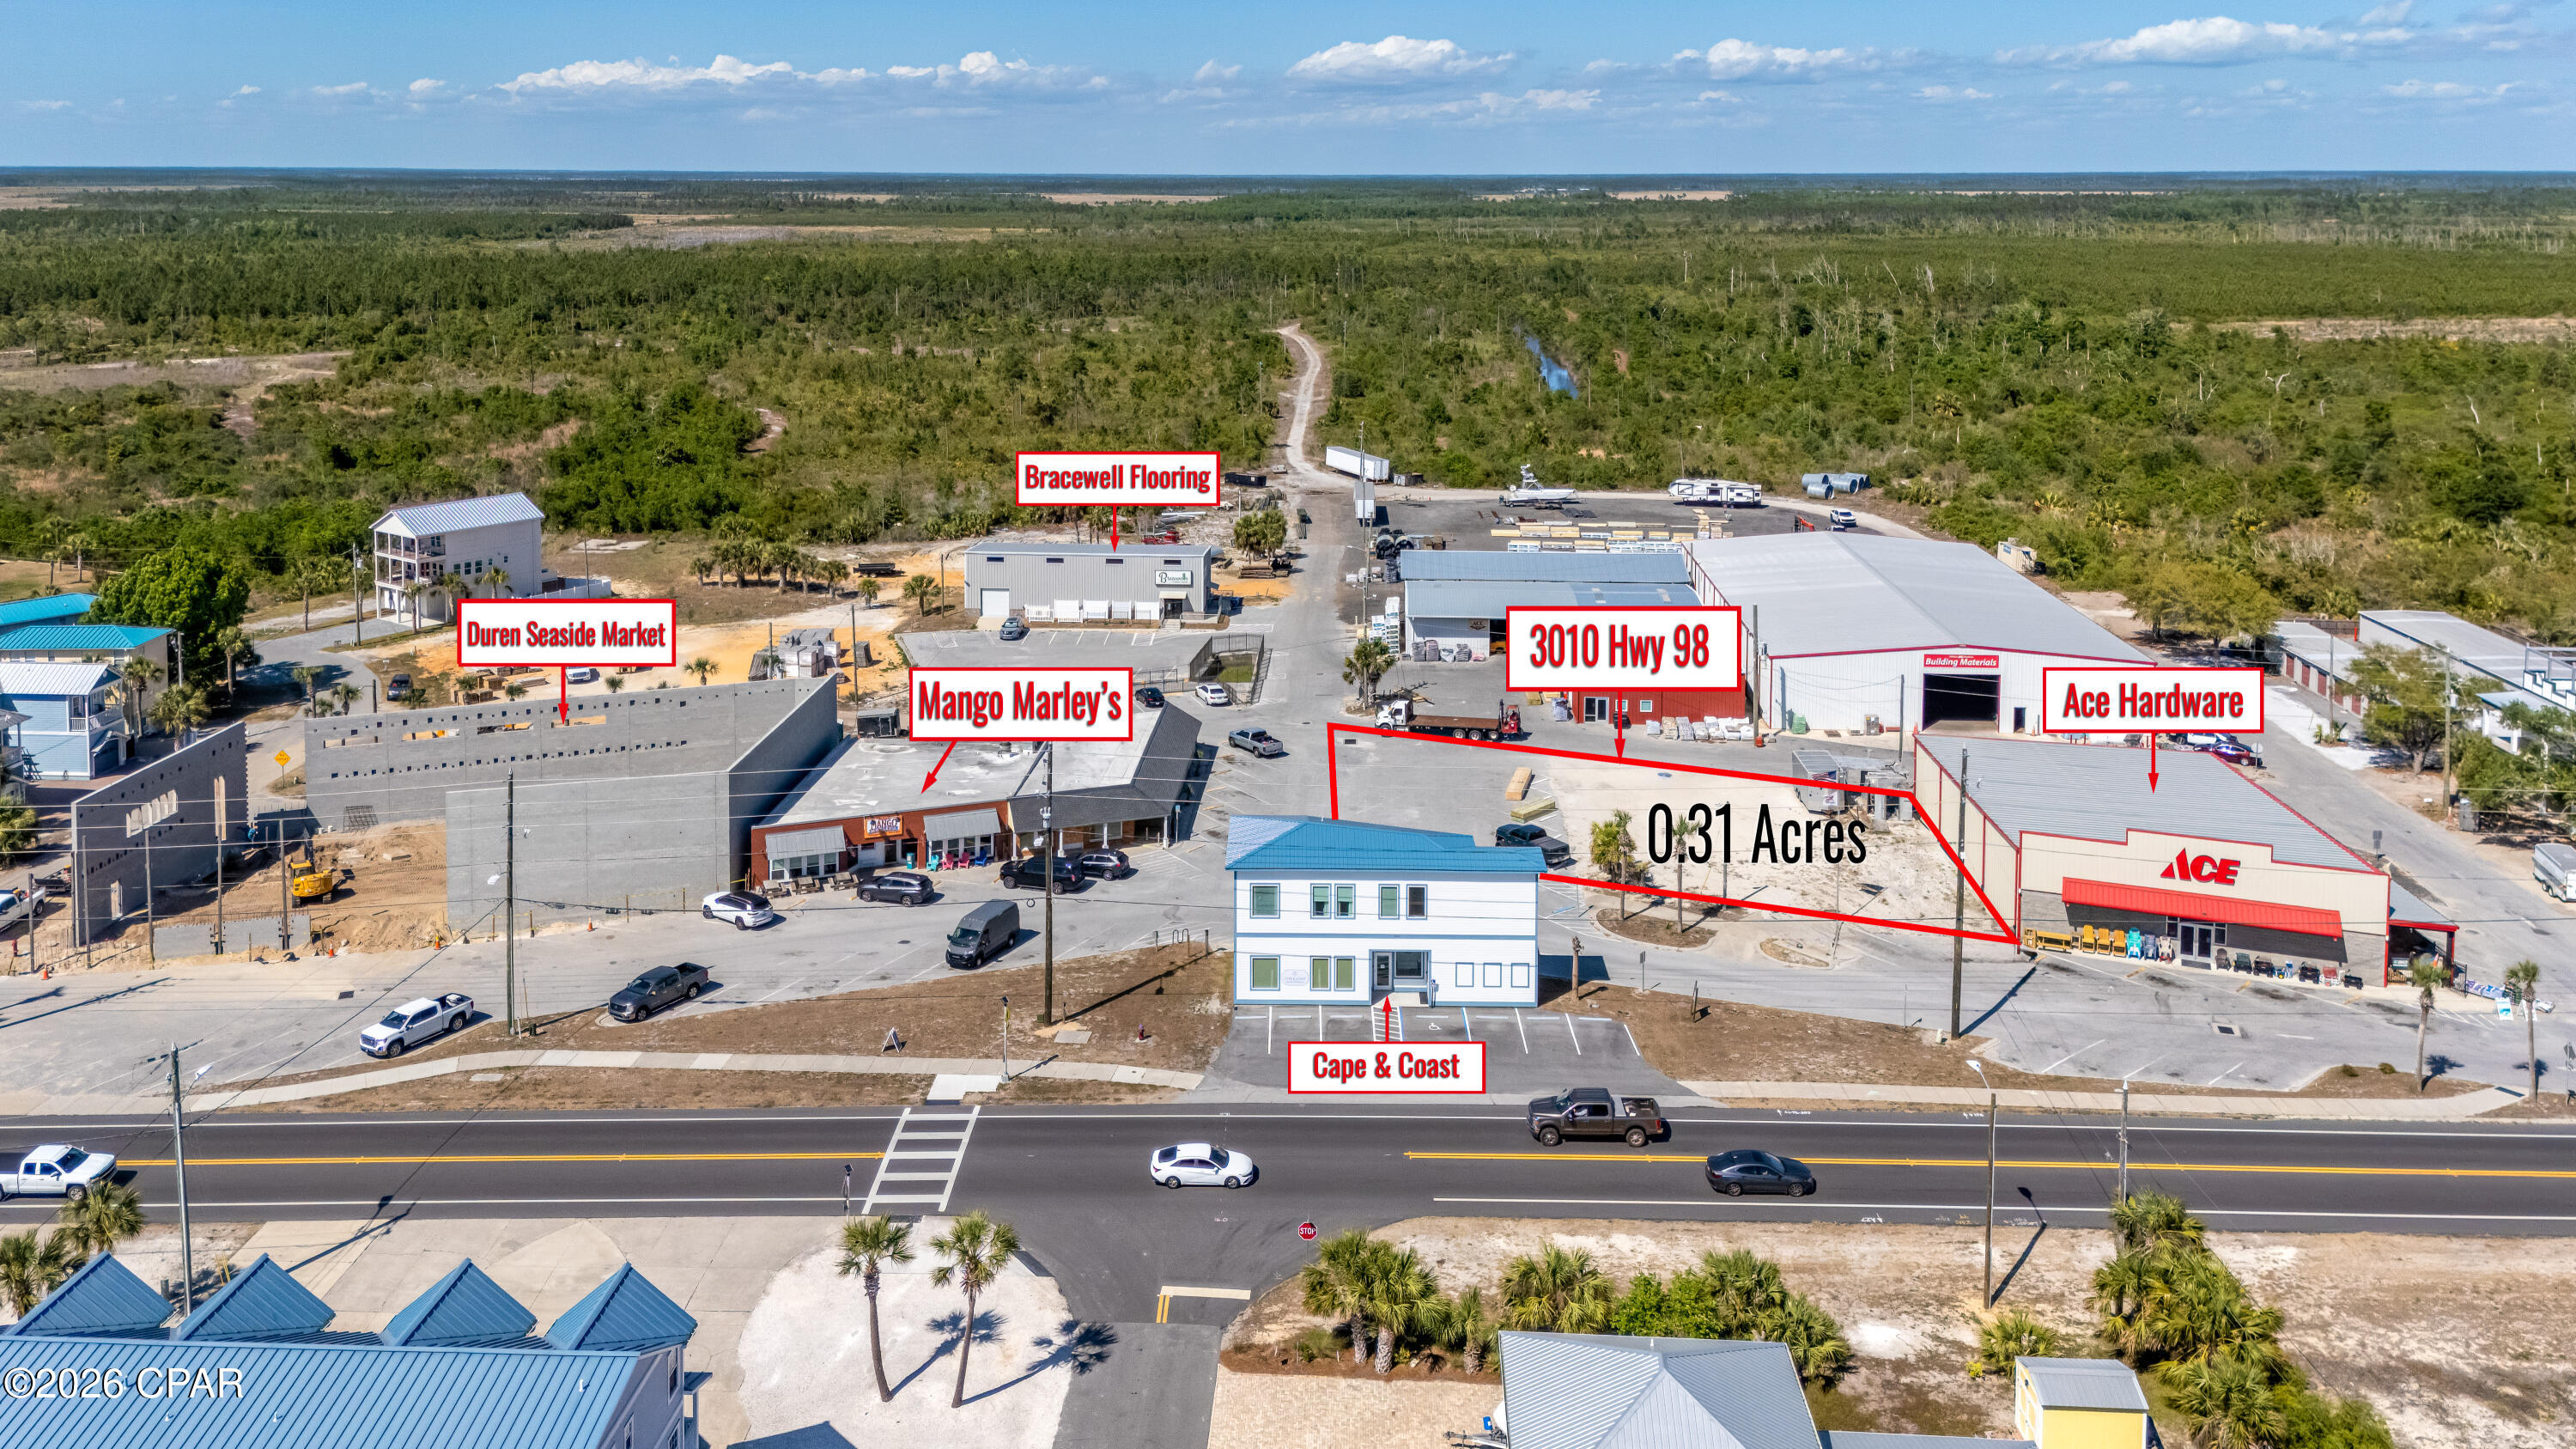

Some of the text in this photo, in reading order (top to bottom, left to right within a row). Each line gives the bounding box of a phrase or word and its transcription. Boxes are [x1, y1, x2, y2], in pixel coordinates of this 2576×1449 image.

[1925, 658, 1996, 667] Building Materials
[871, 819, 897, 831] MANGO
[2160, 848, 2241, 886] ACE
